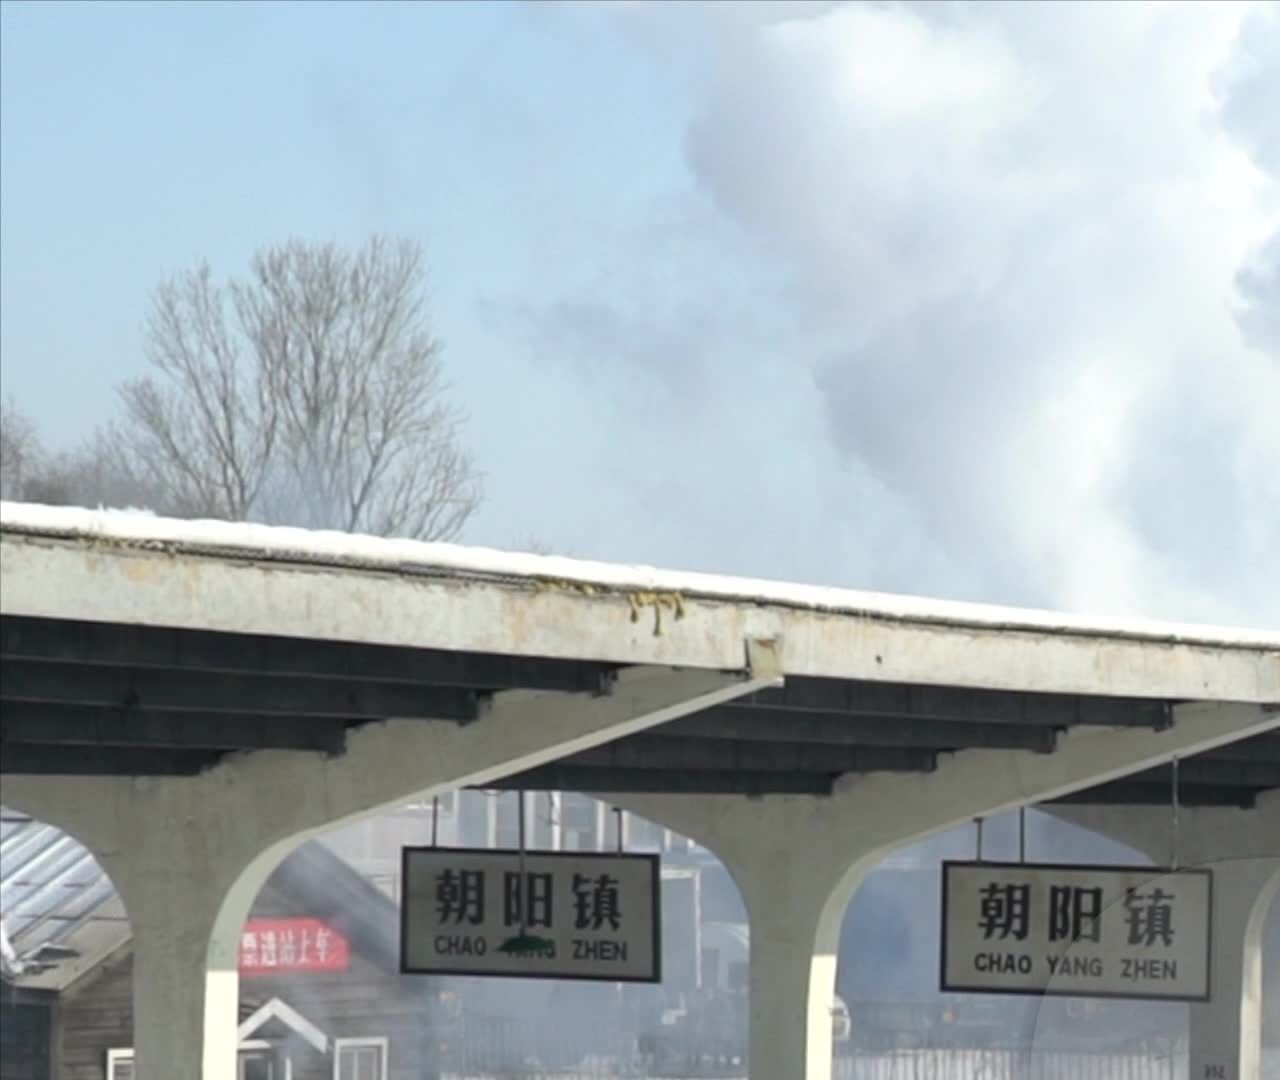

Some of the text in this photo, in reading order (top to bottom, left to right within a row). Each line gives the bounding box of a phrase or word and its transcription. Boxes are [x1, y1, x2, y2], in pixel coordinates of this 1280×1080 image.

[436, 869, 622, 930] 朝阳镇
[979, 883, 1175, 946] 朝阳镇
[434, 936, 487, 956] CHAO
[573, 941, 627, 961] ZHEN
[974, 953, 1177, 980] CHAO YANG ZHEN
